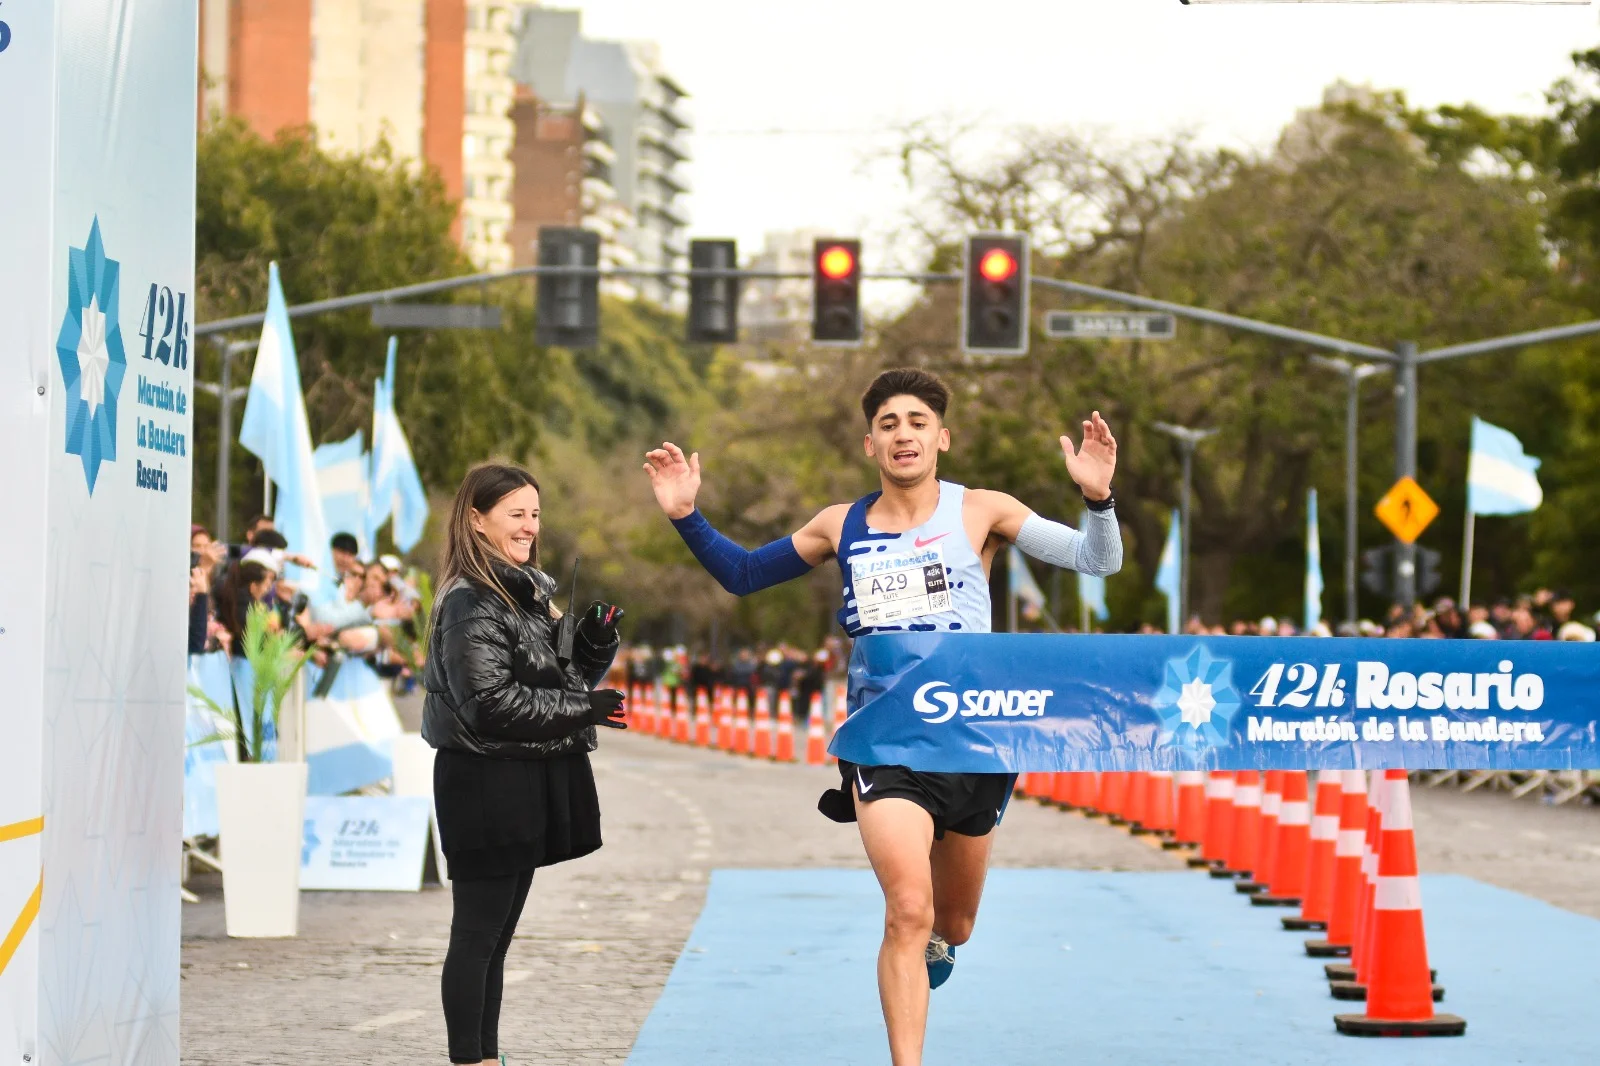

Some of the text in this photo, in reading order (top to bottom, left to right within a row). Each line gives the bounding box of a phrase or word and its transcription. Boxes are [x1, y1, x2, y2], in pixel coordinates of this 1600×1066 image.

[139, 283, 188, 370] 42k
[138, 374, 187, 415] Maratón de
[137, 416, 186, 458] la Bandera
[136, 459, 168, 493] Rosario
[872, 573, 907, 595] A29
[1249, 660, 1544, 711] 42k Rosario
[1247, 715, 1545, 743] Maratón de la Bandera
